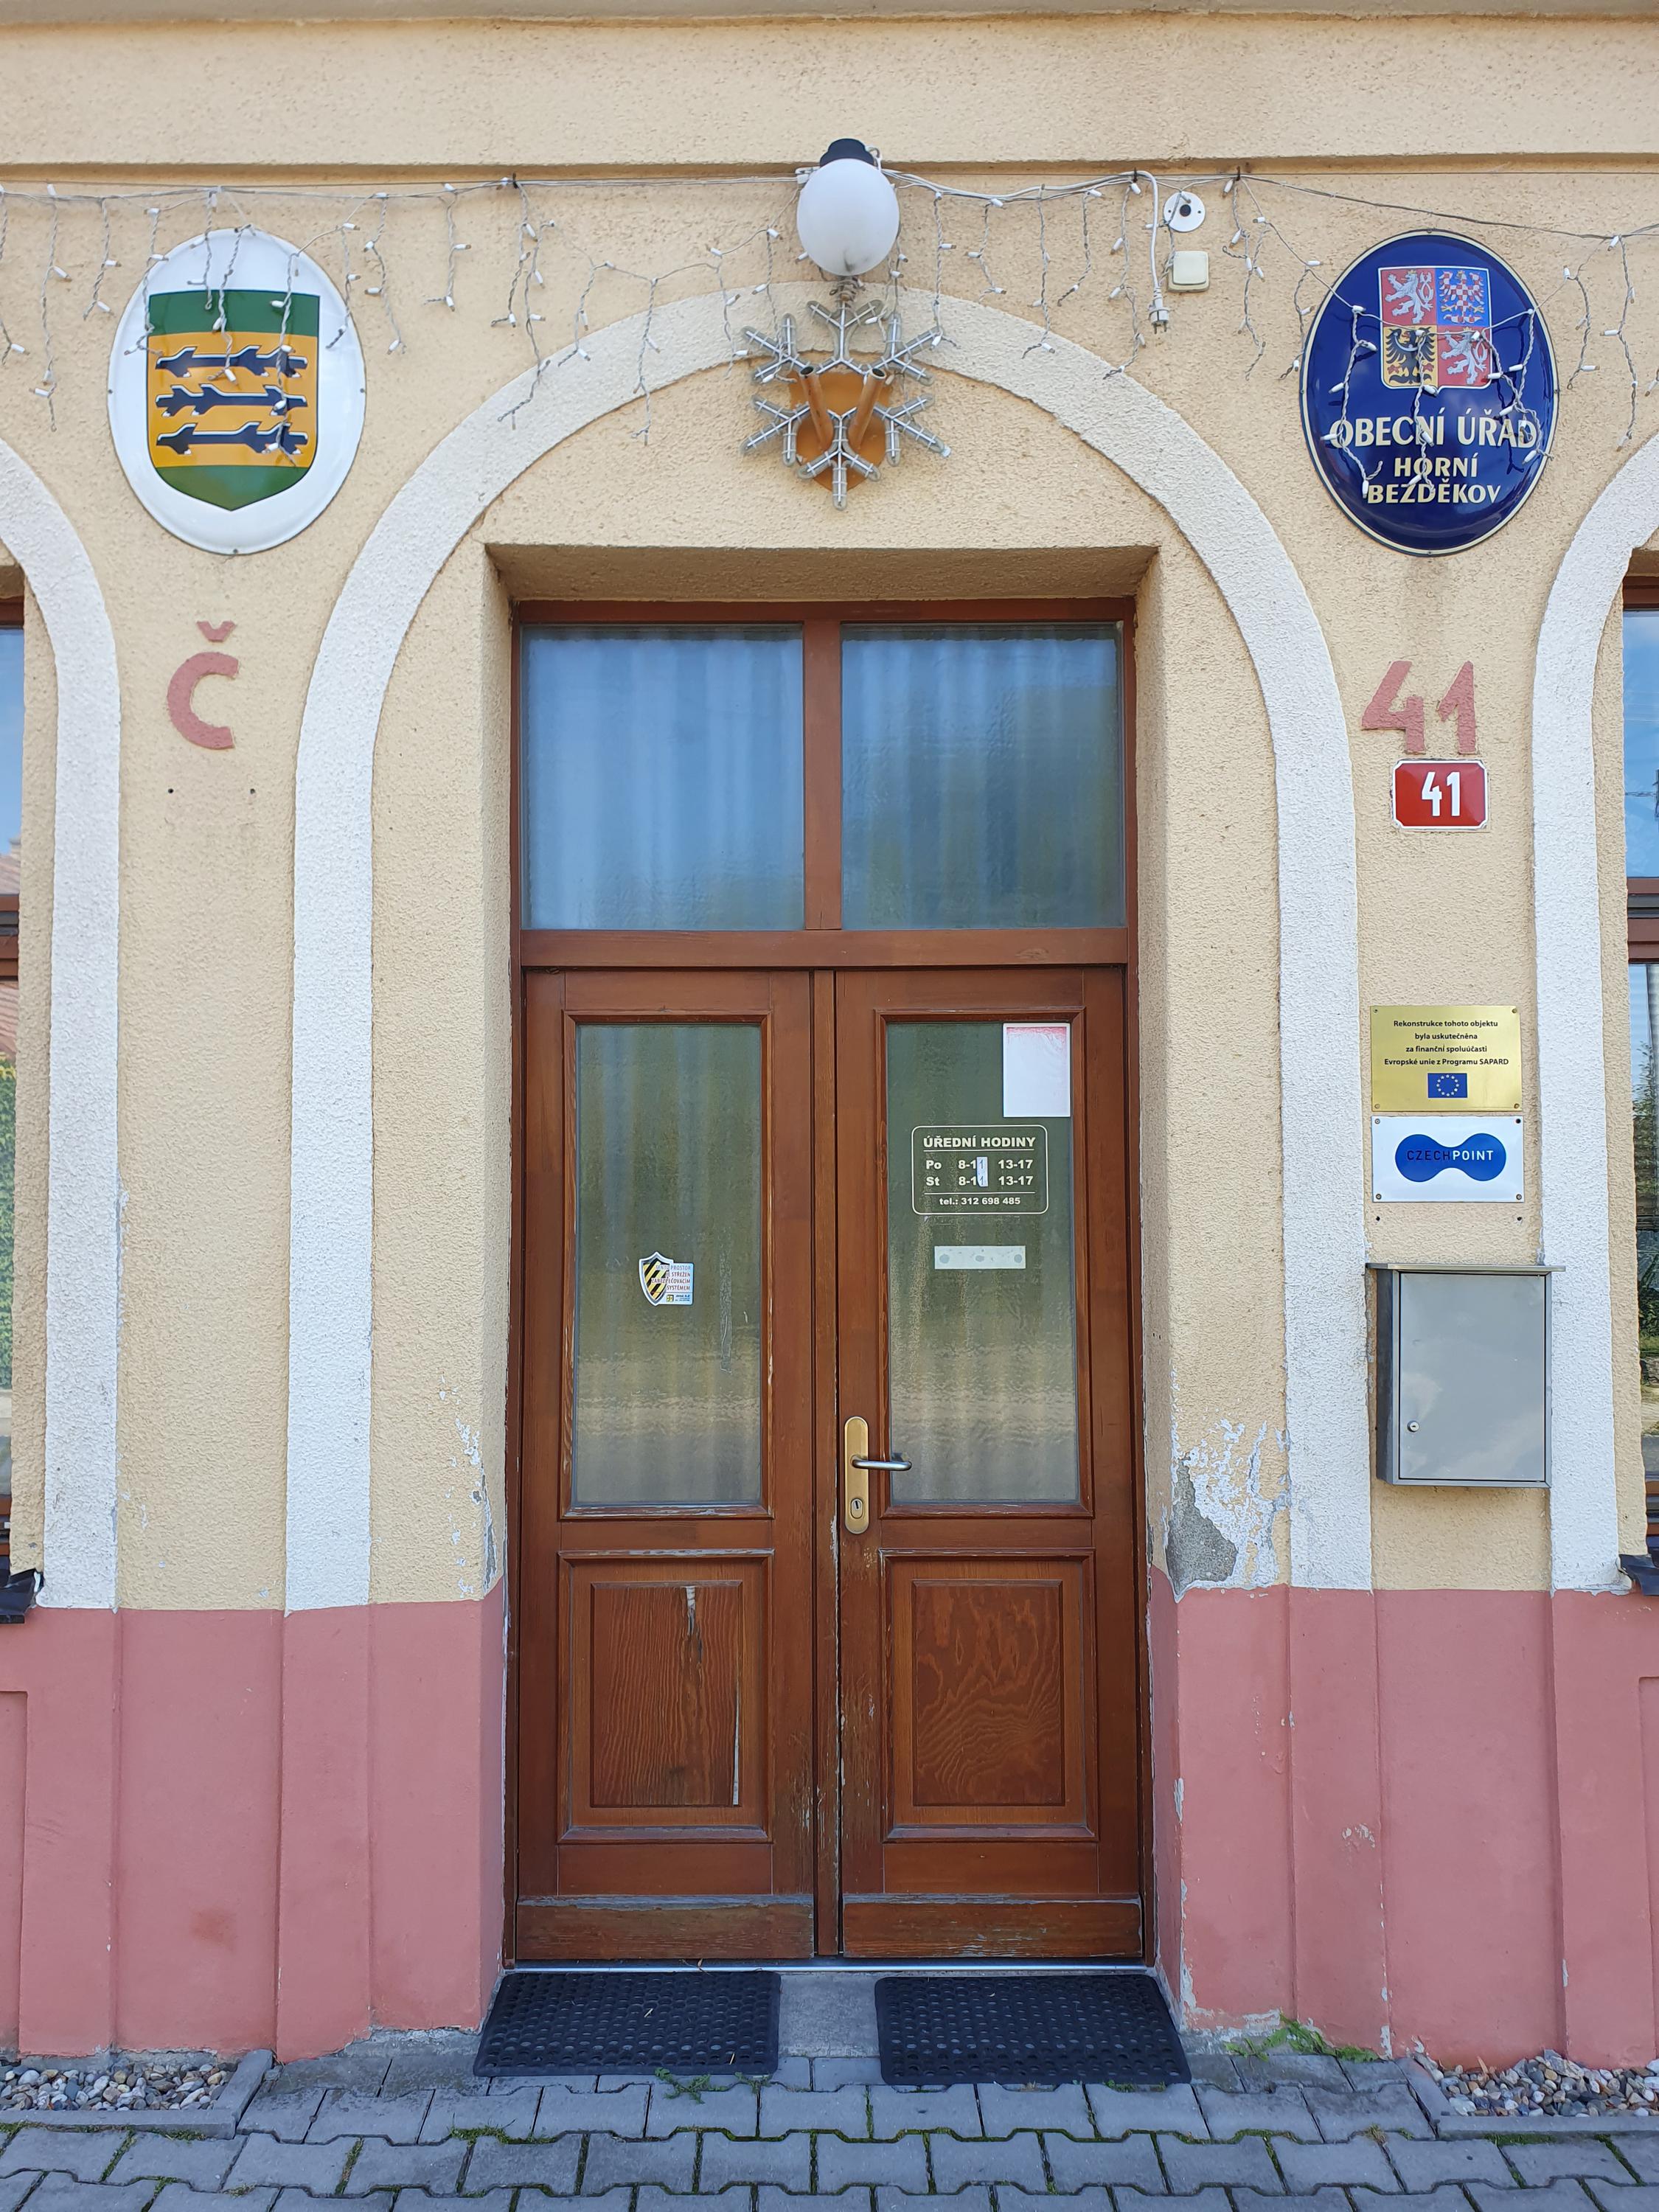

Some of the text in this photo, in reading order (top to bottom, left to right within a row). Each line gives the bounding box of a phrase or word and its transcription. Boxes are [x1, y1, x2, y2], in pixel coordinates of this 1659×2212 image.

[1329, 407, 1537, 448] OBECNÍ ÚŘAD
[1394, 453, 1478, 477] HORNÍ
[1368, 478, 1501, 504] BEZDĚKOV
[167, 620, 239, 751] Č
[1361, 661, 1477, 754] 41
[1422, 772, 1461, 817] 41
[1470, 1020, 1498, 1029] objektu
[1447, 1046, 1487, 1054] spoluúčasti
[1384, 1058, 1418, 1066] Evropské
[1442, 1059, 1478, 1067] Programu
[923, 1135, 1036, 1148] ÚŘEDNÍ HODINY
[926, 1160, 942, 1169] Po
[998, 1160, 1034, 1169] 13-17
[926, 1176, 940, 1186] St
[998, 1176, 1034, 1186] 13-17
